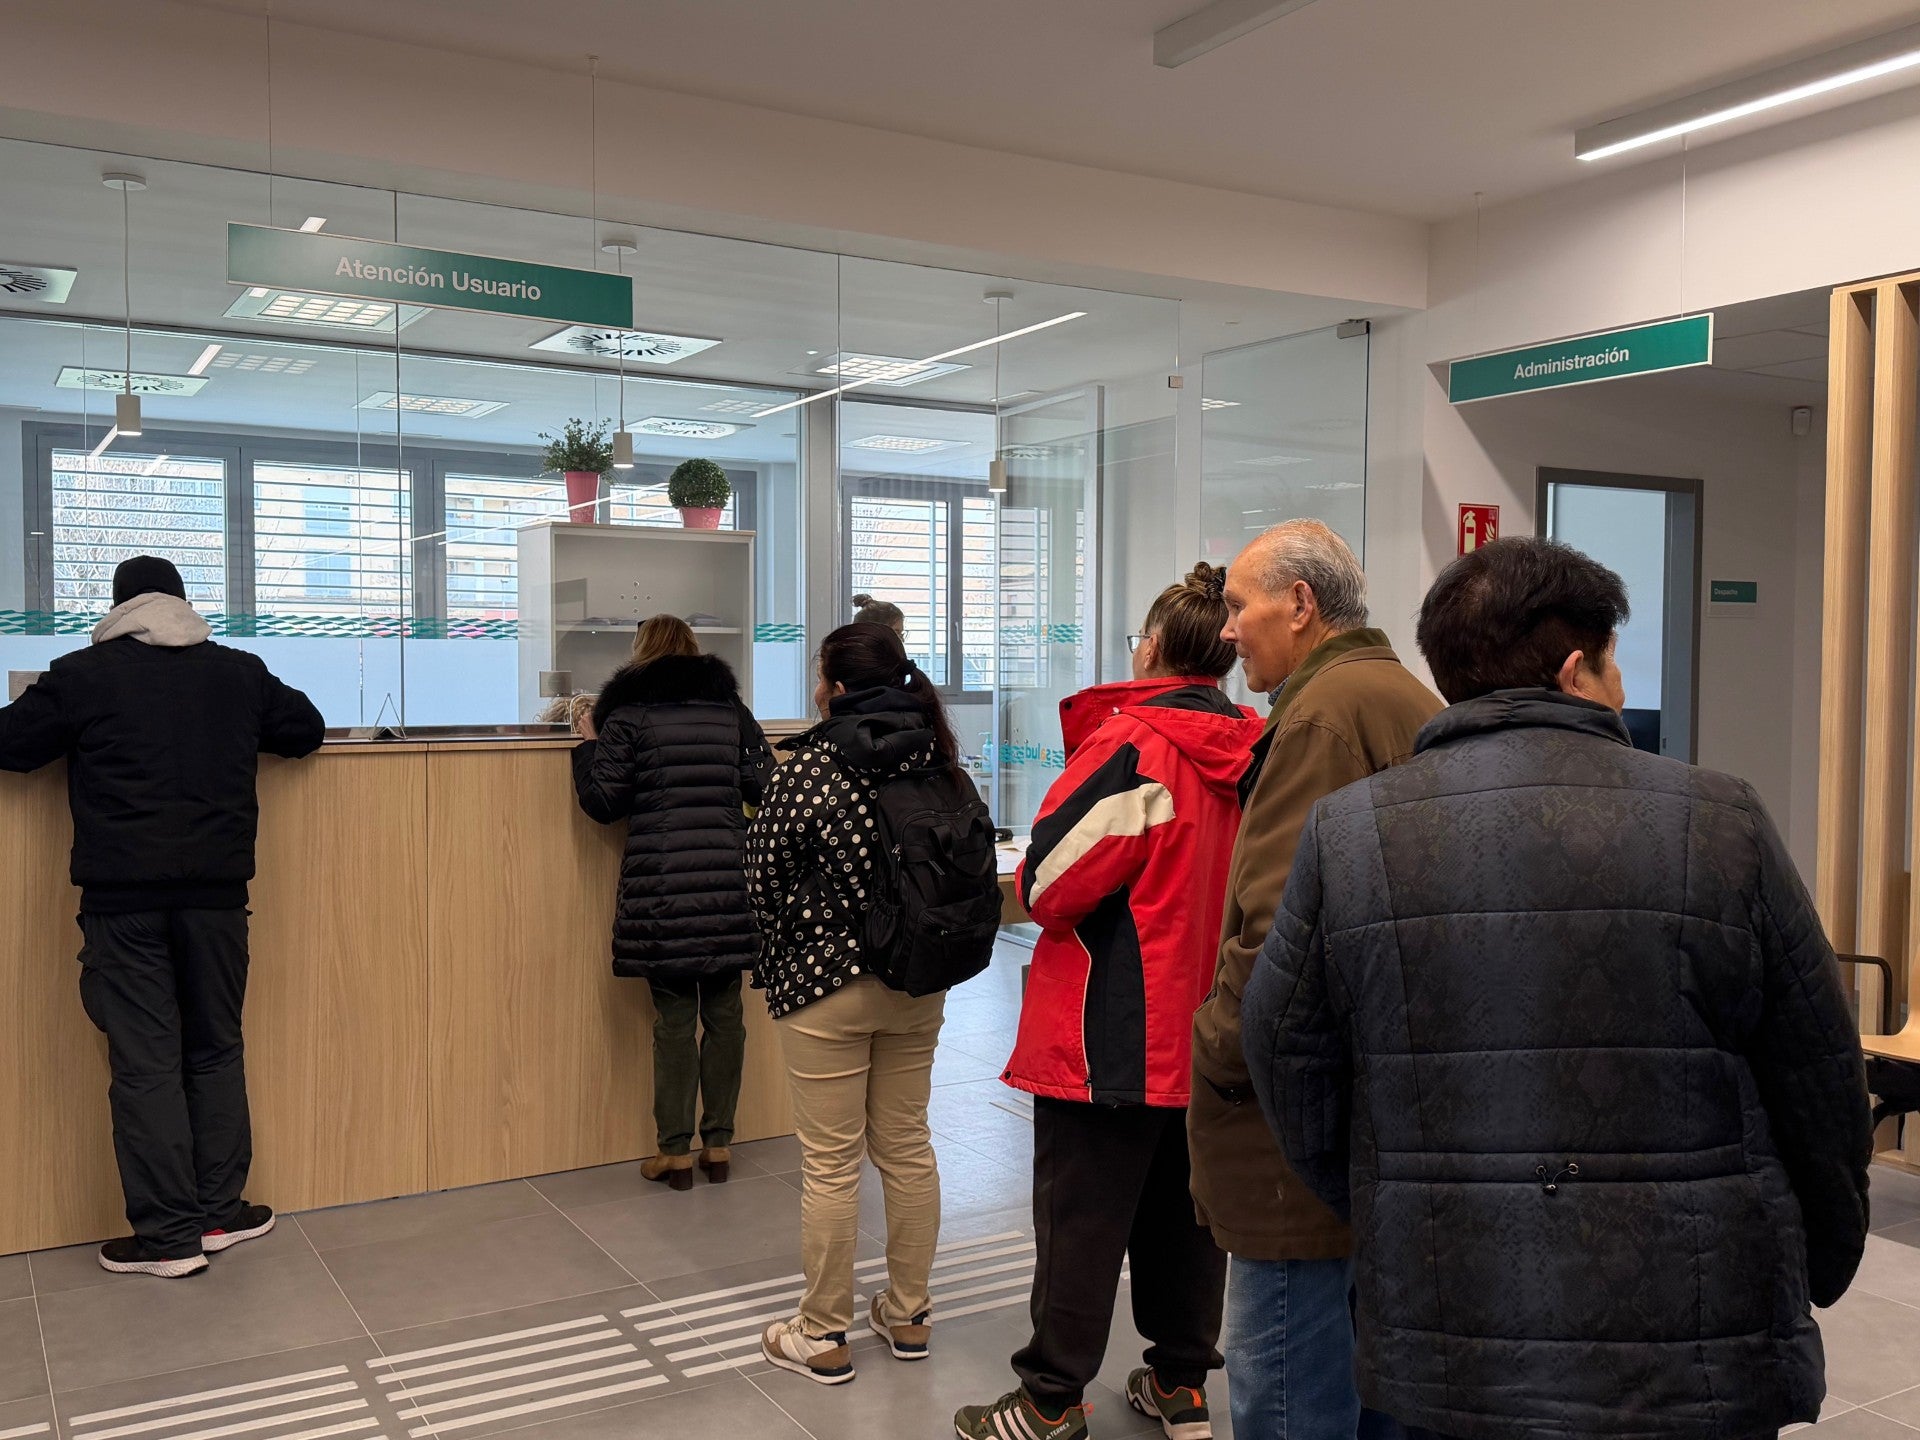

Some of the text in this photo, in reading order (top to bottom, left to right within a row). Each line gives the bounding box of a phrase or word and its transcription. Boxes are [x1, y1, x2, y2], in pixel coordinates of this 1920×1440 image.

[335, 256, 541, 301] Atención Usuario
[1514, 346, 1630, 380] Administración
